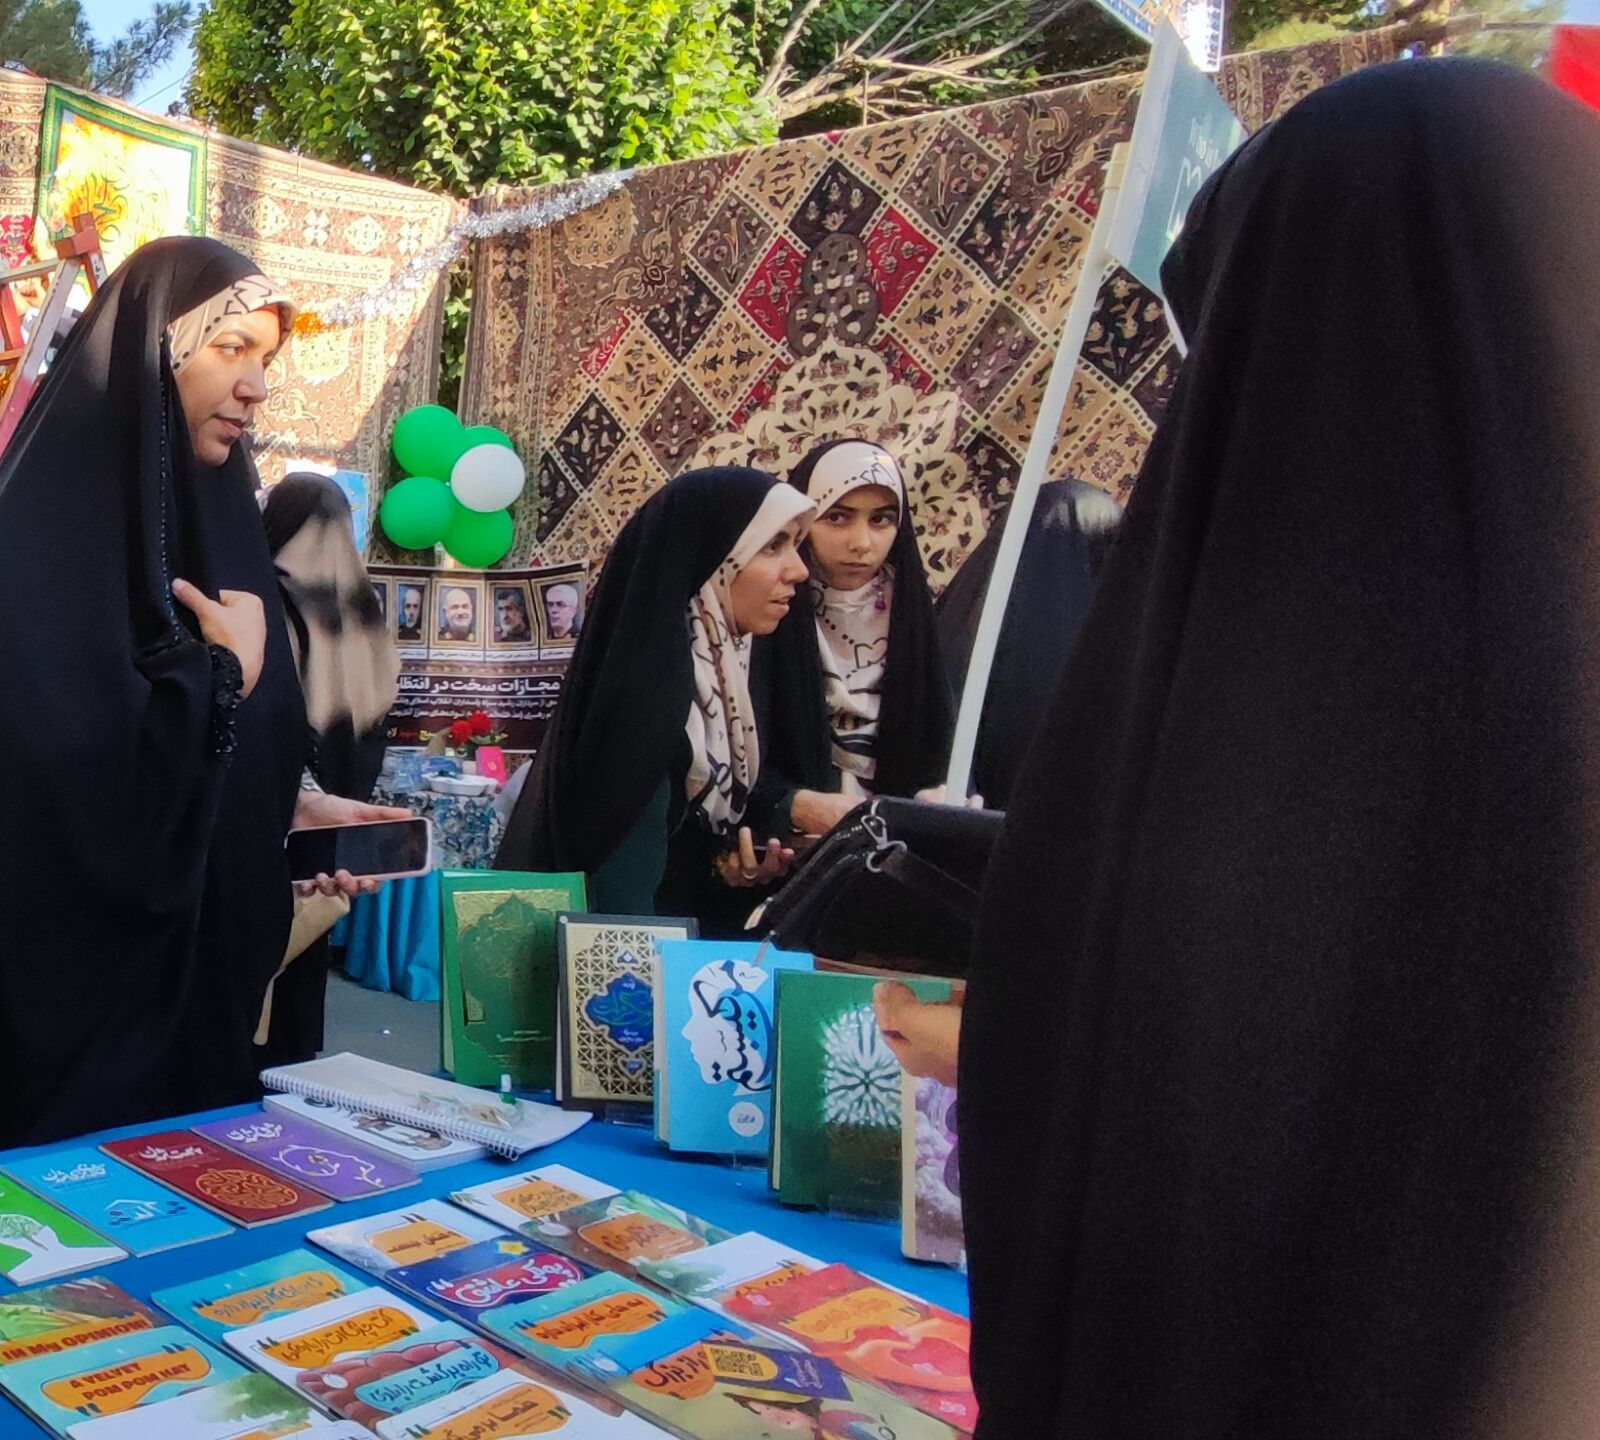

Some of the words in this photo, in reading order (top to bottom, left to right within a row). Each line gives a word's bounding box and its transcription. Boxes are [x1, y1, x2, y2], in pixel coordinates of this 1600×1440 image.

[398, 674, 430, 690] انتظا
[430, 678, 449, 694] در
[449, 675, 496, 693] سخت
[496, 676, 560, 695] مجازات
[2, 1348, 28, 1361] IN
[60, 1319, 150, 1348] OPINION
[69, 1378, 84, 1389] A
[83, 1362, 143, 1385] VELVET
[82, 1383, 123, 1401] POM
[121, 1372, 160, 1391] POM
[158, 1363, 192, 1379] HAT
